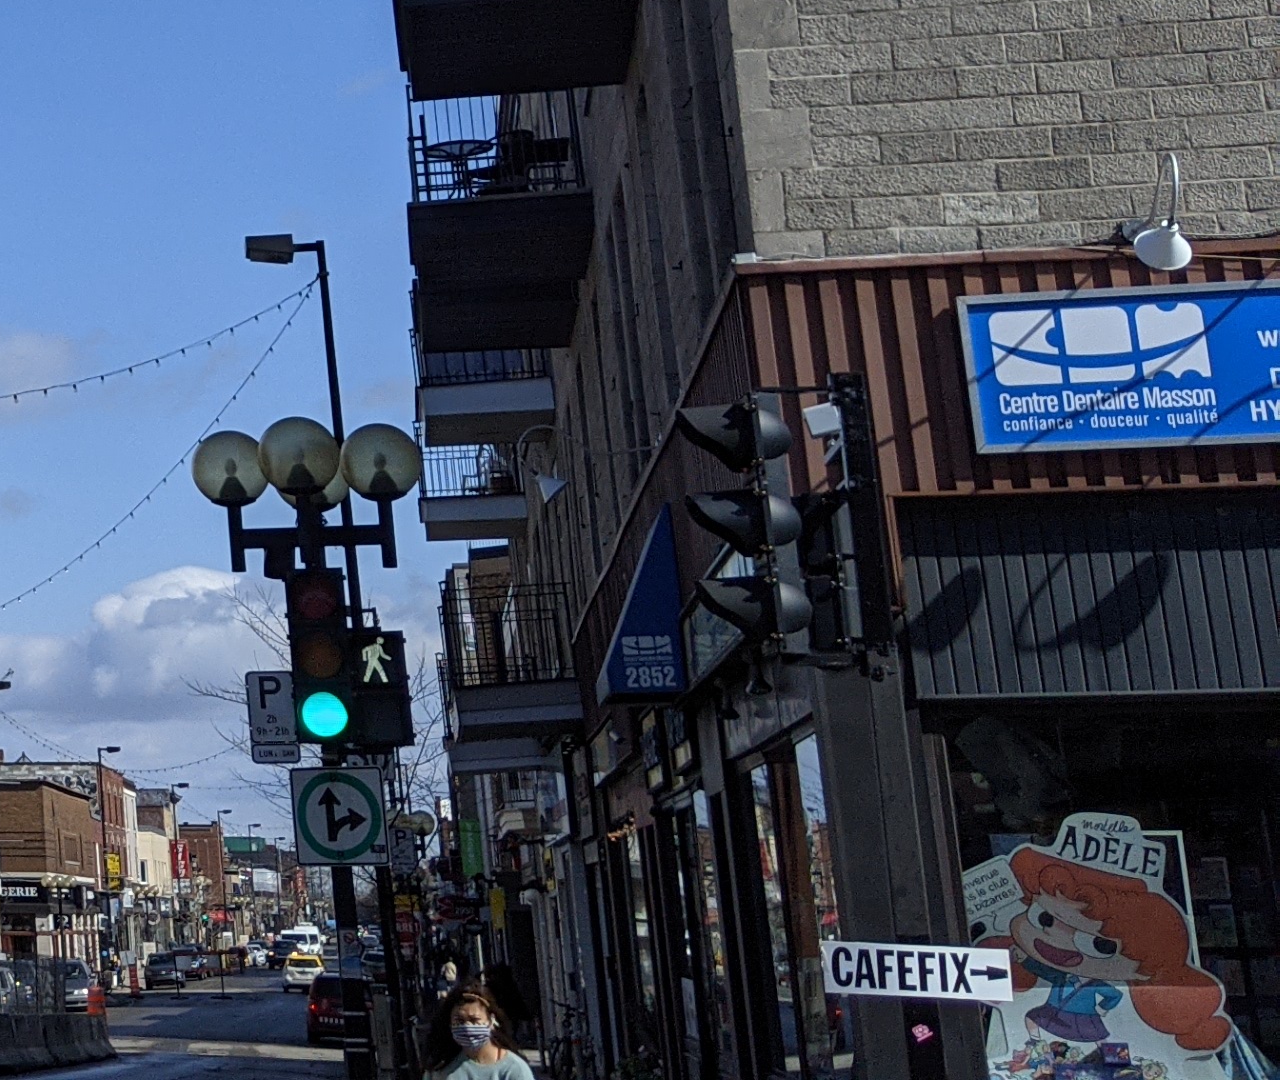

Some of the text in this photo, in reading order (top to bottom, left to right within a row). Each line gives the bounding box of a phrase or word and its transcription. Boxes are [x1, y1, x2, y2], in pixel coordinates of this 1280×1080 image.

[999, 387, 1217, 415] Centre Dentaire Masson
[1003, 408, 1219, 432] confiance douceur qualité
[626, 666, 677, 688] 2852
[258, 676, 282, 709] P
[267, 714, 277, 723] 2h
[1082, 819, 1135, 833] mortelle
[395, 830, 406, 846] P
[1056, 825, 1162, 878] ADÈLE
[975, 887, 986, 897] le
[988, 877, 1009, 891] club
[831, 947, 973, 994] CAFEFIX
